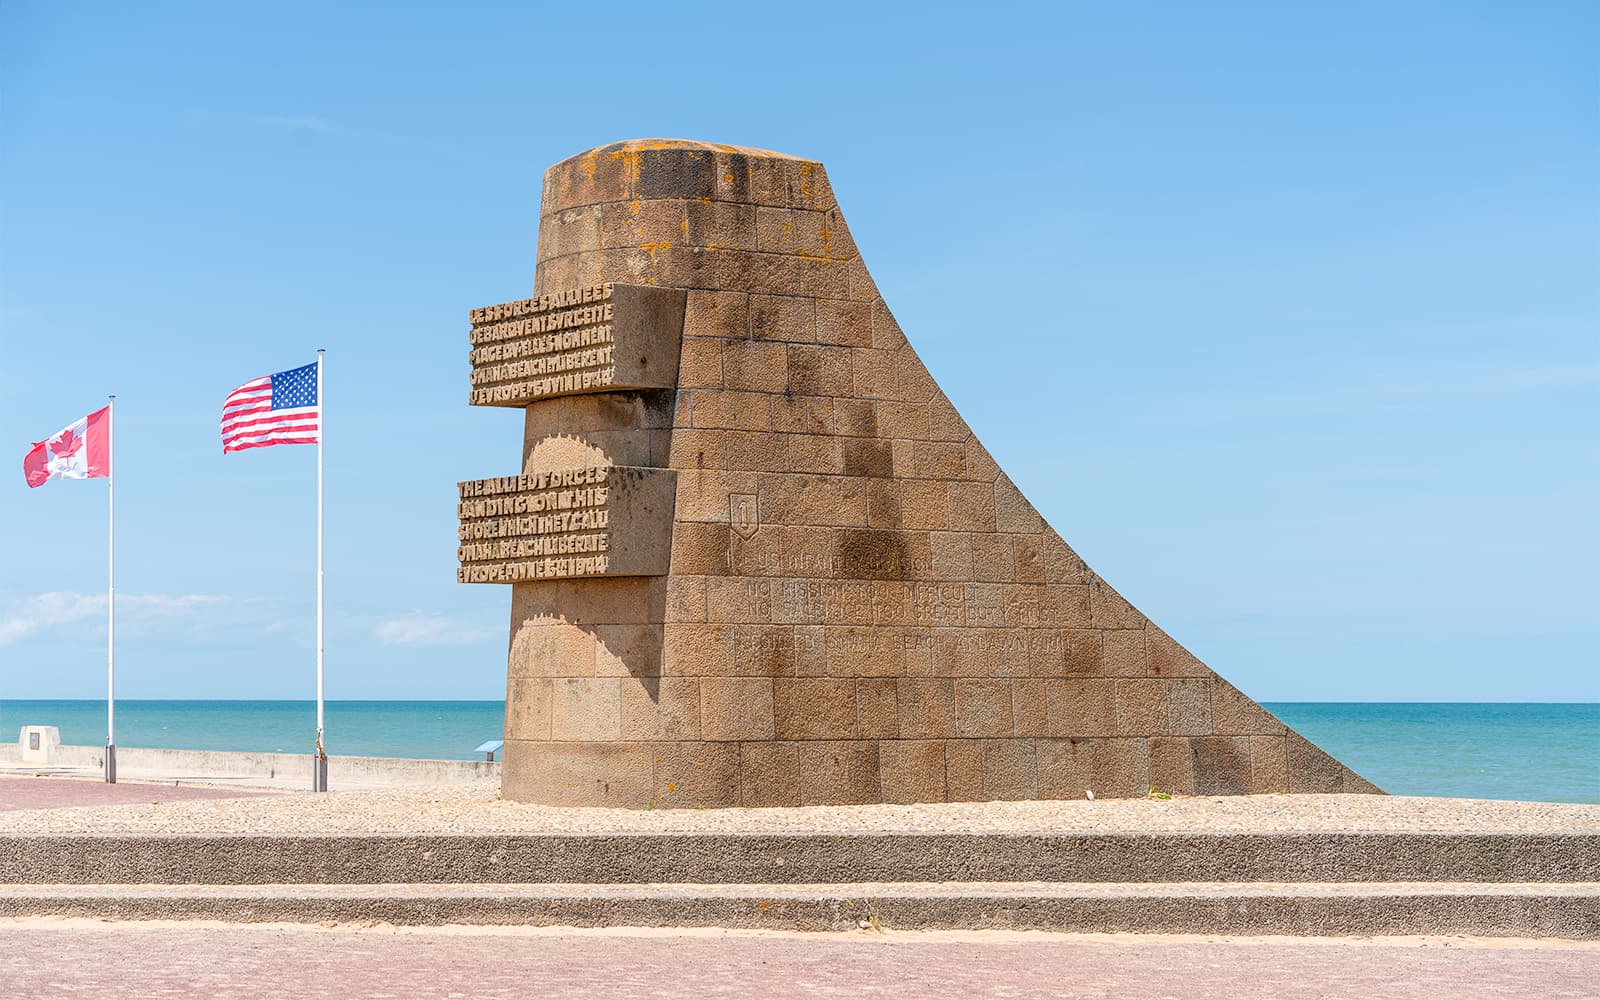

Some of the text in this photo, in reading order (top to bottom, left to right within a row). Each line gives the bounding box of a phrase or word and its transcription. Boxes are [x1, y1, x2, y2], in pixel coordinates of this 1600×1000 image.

[469, 282, 614, 324] LES FORCES ALLIEES
[574, 302, 614, 328] CETTE
[470, 346, 503, 366] PLAGE
[553, 323, 614, 353] NOMMENT
[470, 363, 510, 386] OMAHA
[510, 356, 546, 380] BEACH
[457, 464, 609, 499] THE ALLIED FORCES
[457, 495, 527, 520] LANDING
[458, 507, 609, 542] SHORE WHICH THEY CALL
[457, 531, 609, 563] OMAHA BEACH LIBERATE
[747, 581, 770, 598] NO
[781, 581, 846, 600] MISSION
[747, 601, 770, 618] NO
